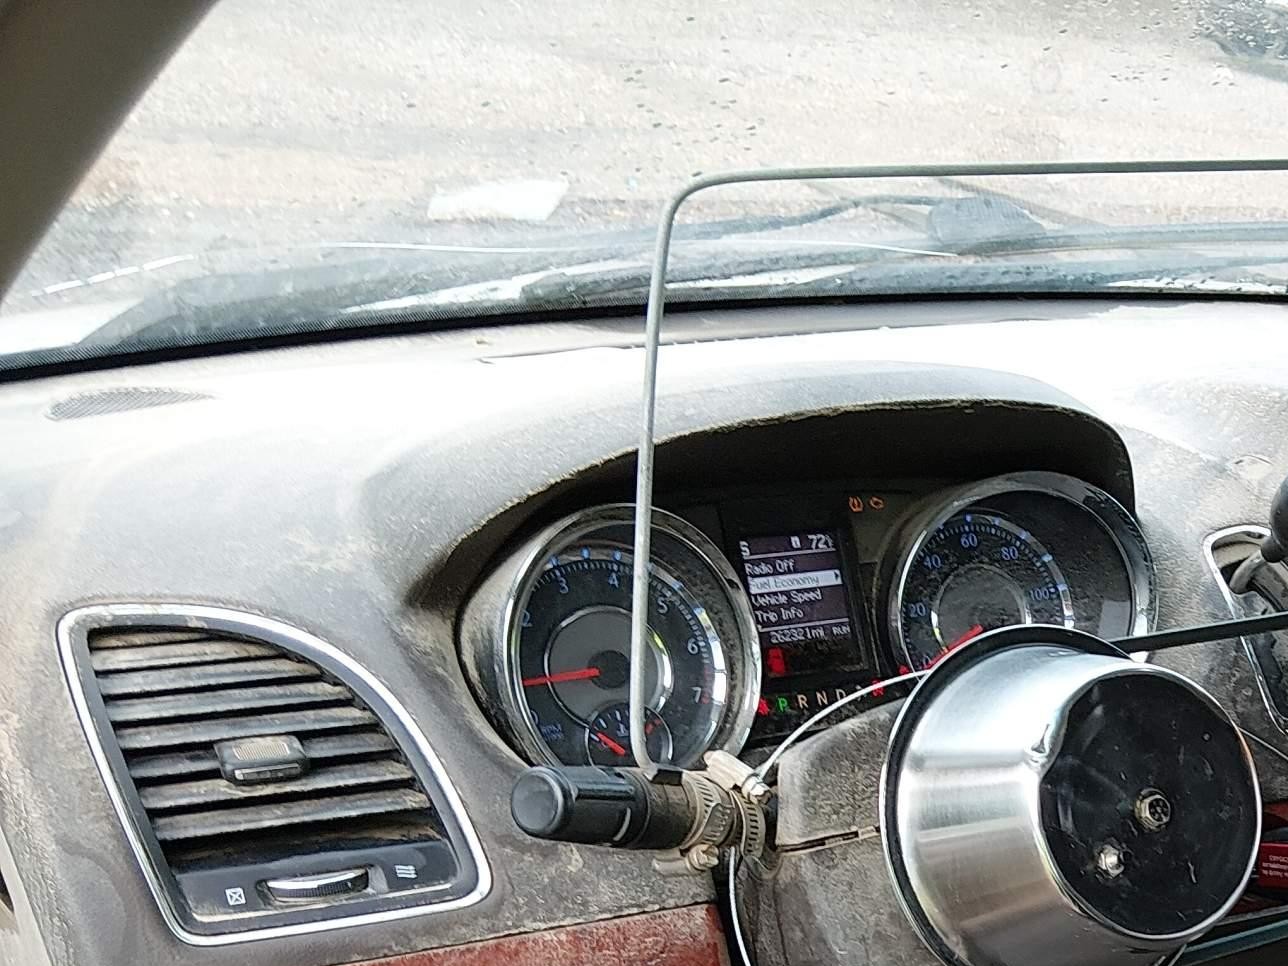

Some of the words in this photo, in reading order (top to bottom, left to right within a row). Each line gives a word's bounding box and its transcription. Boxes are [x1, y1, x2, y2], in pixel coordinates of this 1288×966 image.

[960, 532, 978, 548] 60
[1000, 546, 1019, 561] 80
[744, 562, 774, 577] Radio
[775, 559, 795, 574] Off
[923, 554, 941, 570] 40
[557, 577, 570, 595] 3
[607, 572, 620, 589] 4
[774, 576, 820, 590] Economy
[751, 593, 789, 608] Vehicle
[790, 588, 823, 604] Speed
[1028, 586, 1050, 601] 100
[656, 599, 669, 614] 5
[909, 602, 927, 618] 20
[755, 609, 778, 624] Trip
[779, 606, 804, 621] Info
[687, 639, 701, 655] 6
[692, 687, 701, 704] 7
[776, 697, 789, 712] P
[797, 694, 809, 710] R
[815, 691, 828, 707] N
